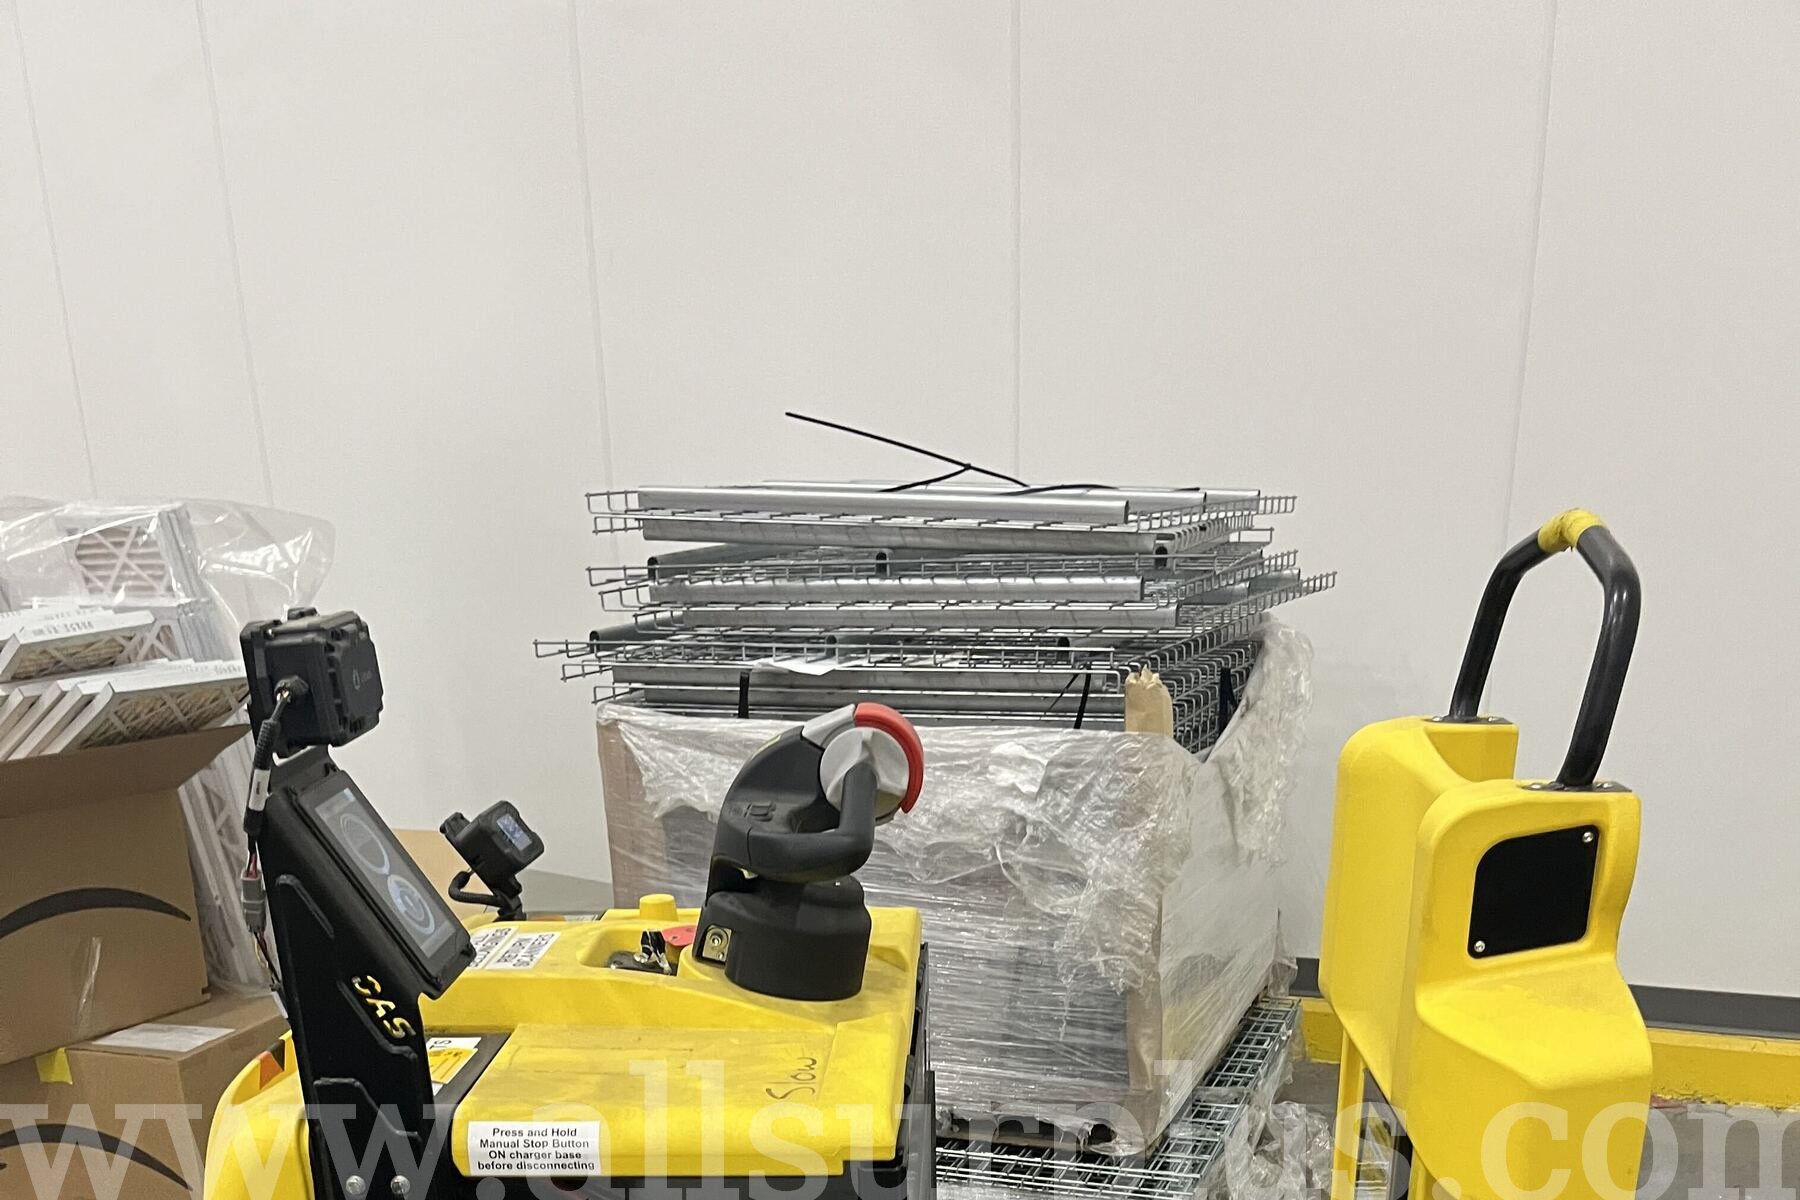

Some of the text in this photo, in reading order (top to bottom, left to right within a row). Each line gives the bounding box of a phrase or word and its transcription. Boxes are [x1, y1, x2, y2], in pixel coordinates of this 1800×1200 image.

[765, 1056, 817, 1100] Slow
[492, 1127, 577, 1137] Press and Hold
[480, 1139, 589, 1150] Manual Stop Button
[488, 1150, 582, 1161] ON charger base
[477, 1161, 595, 1171] before disconnecting
